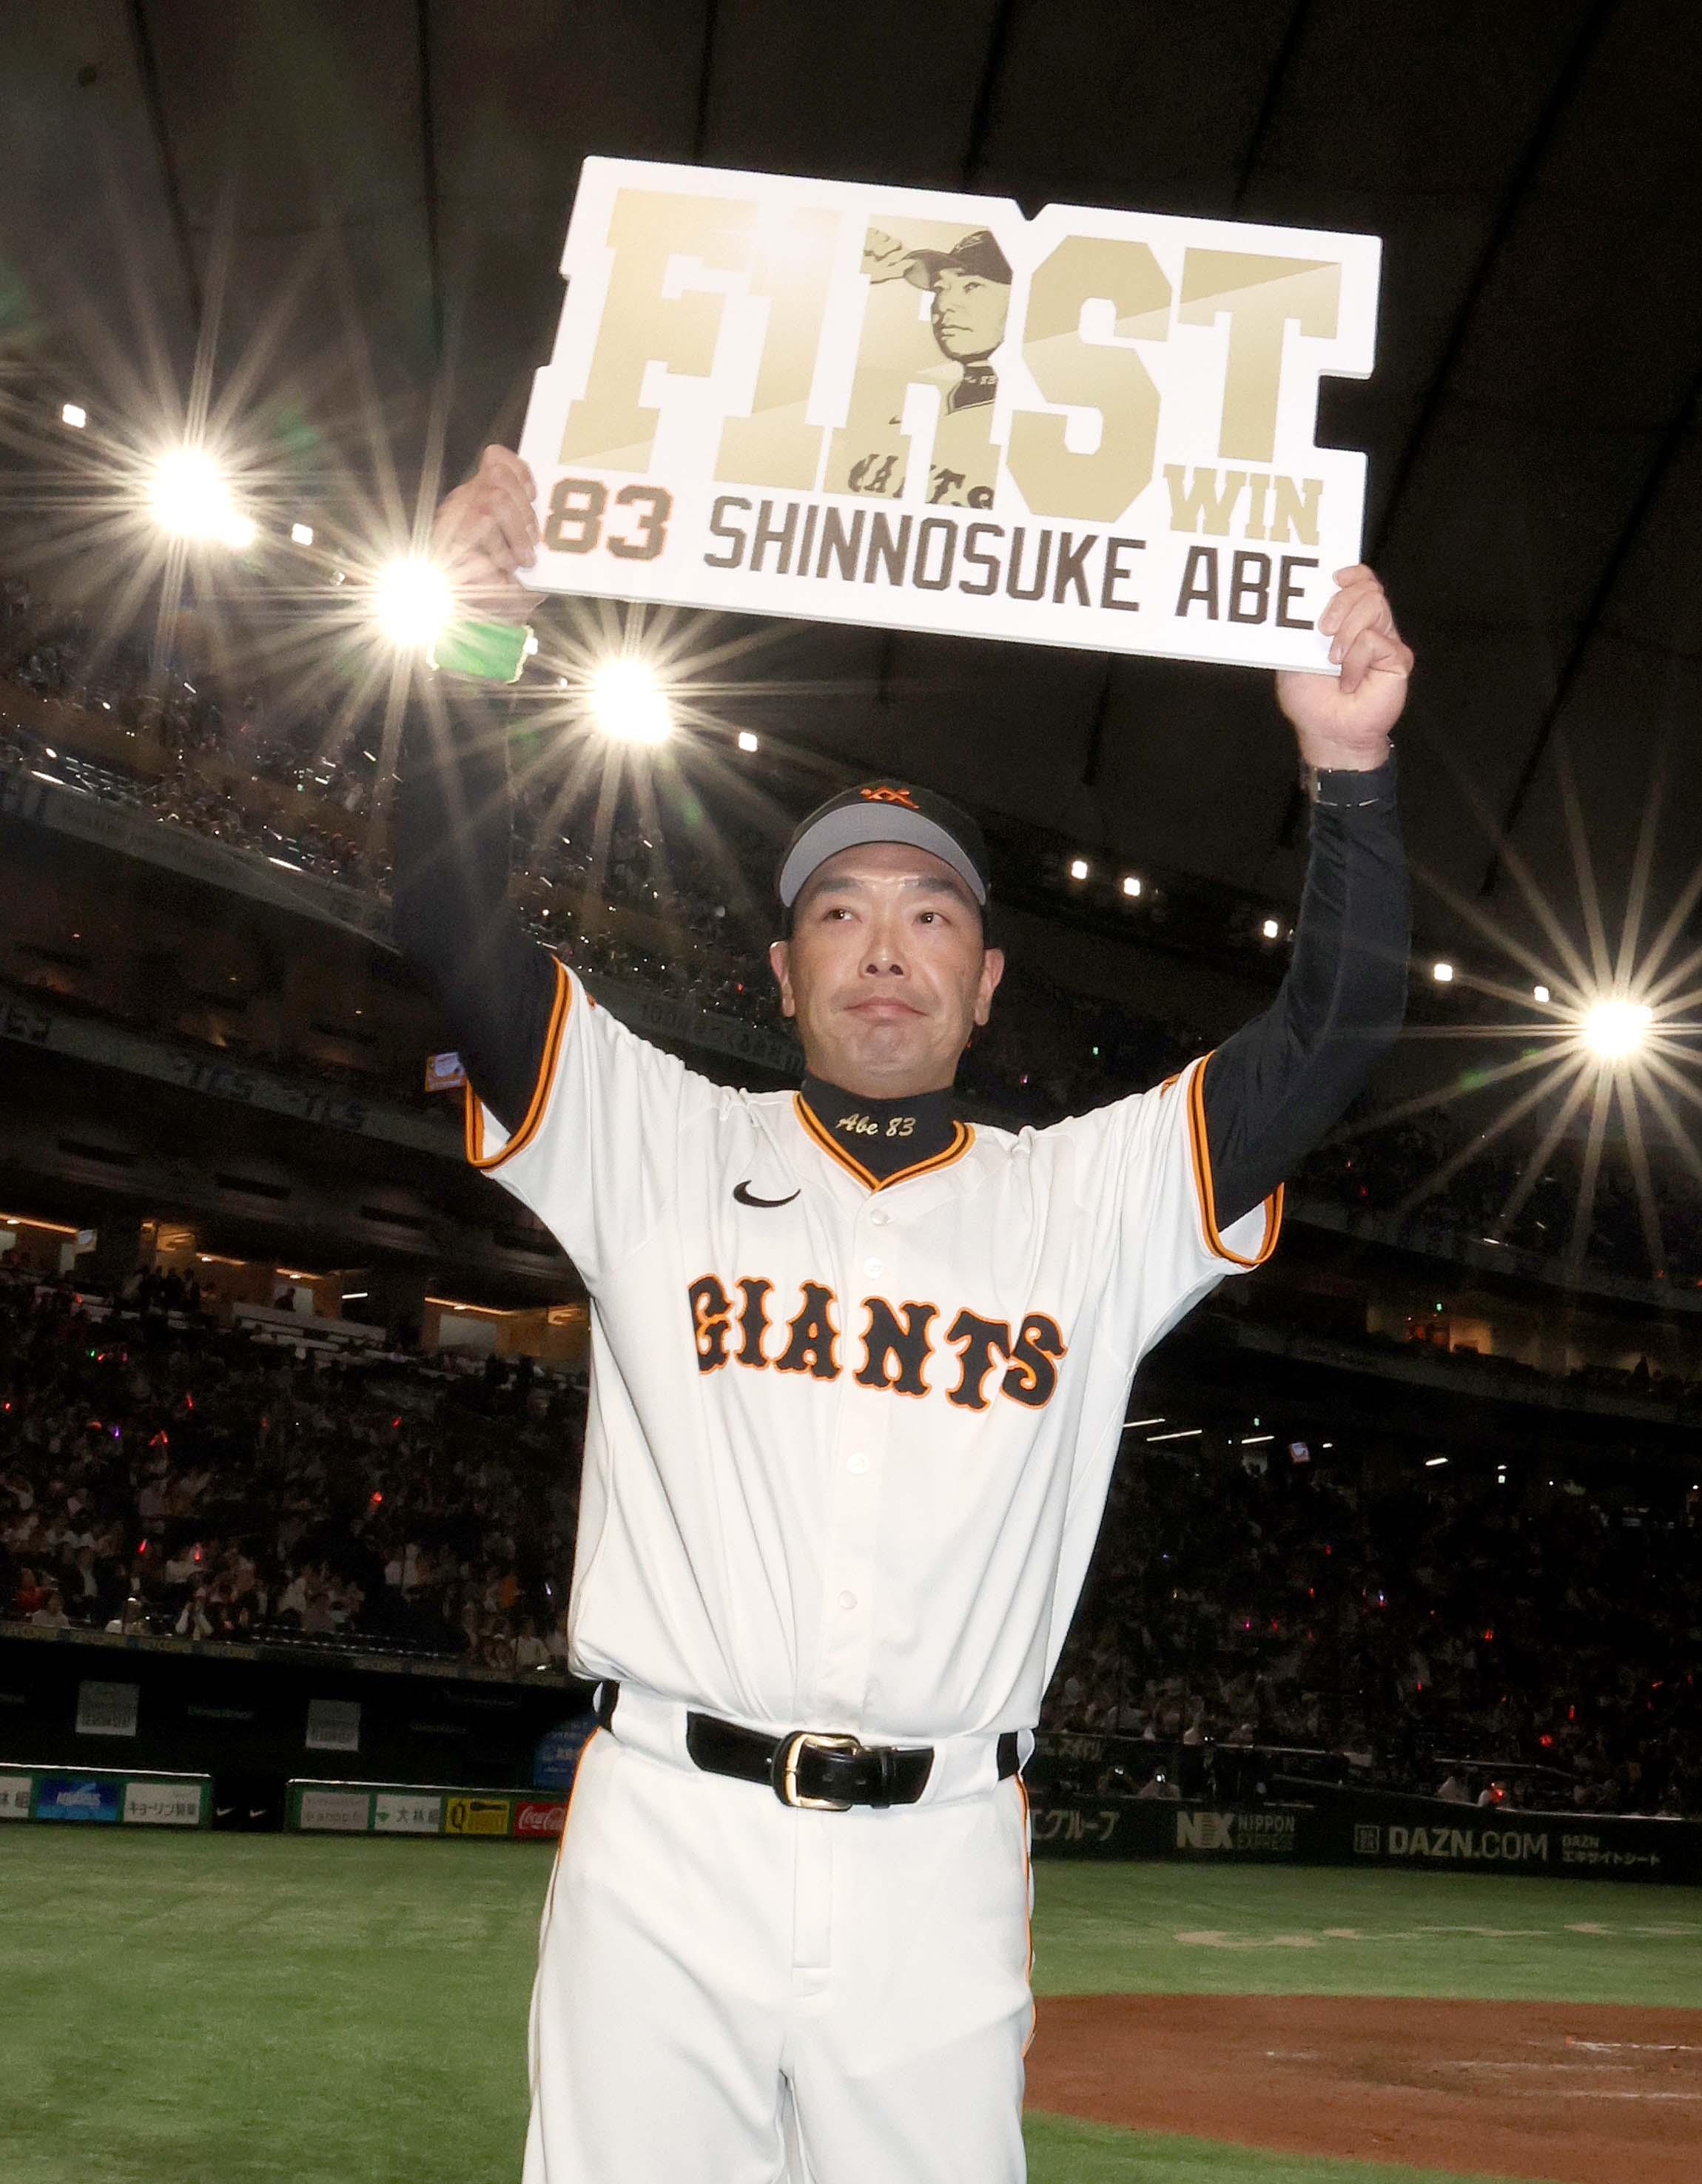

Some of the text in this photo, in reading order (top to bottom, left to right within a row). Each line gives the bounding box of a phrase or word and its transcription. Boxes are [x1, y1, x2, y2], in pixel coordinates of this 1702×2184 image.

[1164, 464, 1324, 546] WIN
[541, 477, 1319, 630] 83 SHINNOSUKE ABE
[835, 1113, 916, 1137] Abe 83
[687, 1273, 1069, 1412] GIANTS
[1177, 1810, 1232, 1849] NX
[1237, 1814, 1294, 1833] NIPPON
[1388, 1825, 1548, 1861] DAZN.COM
